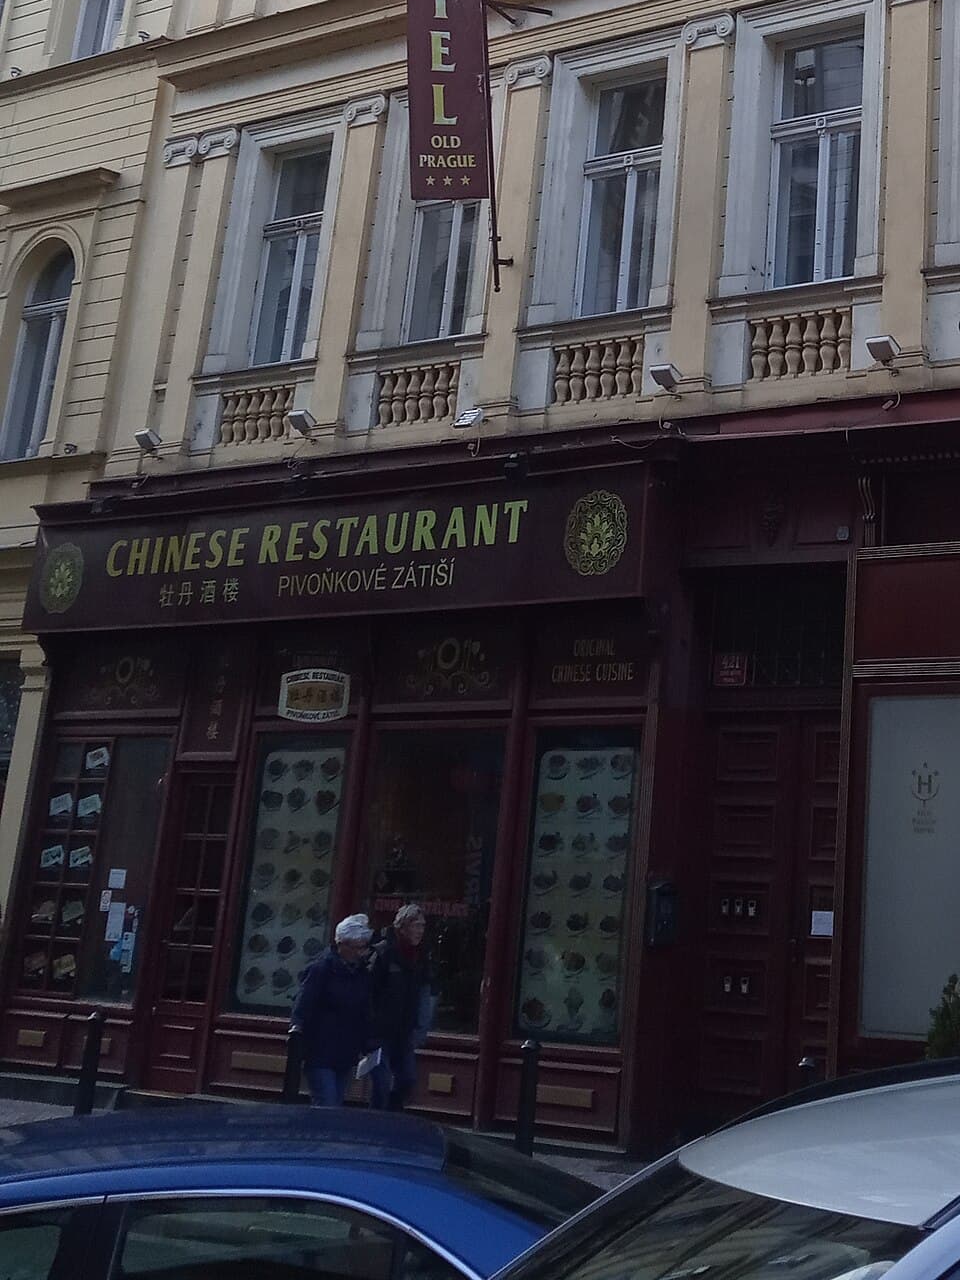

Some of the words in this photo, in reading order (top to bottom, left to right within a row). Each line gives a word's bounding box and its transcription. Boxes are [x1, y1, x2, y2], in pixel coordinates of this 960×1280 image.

[430, 135, 461, 148] OLD
[419, 154, 477, 168] PRAGUE
[106, 527, 250, 577] CHINESE
[257, 500, 529, 564] RESTAURANT
[277, 563, 387, 598] PIVOŇKOVÉ
[391, 557, 456, 589] ZÁTIŠÍ
[158, 577, 241, 609] 牡丹酒楼
[573, 639, 617, 657] ORIGINAL
[551, 664, 592, 683] CHINESE
[595, 662, 635, 682] CUISINE
